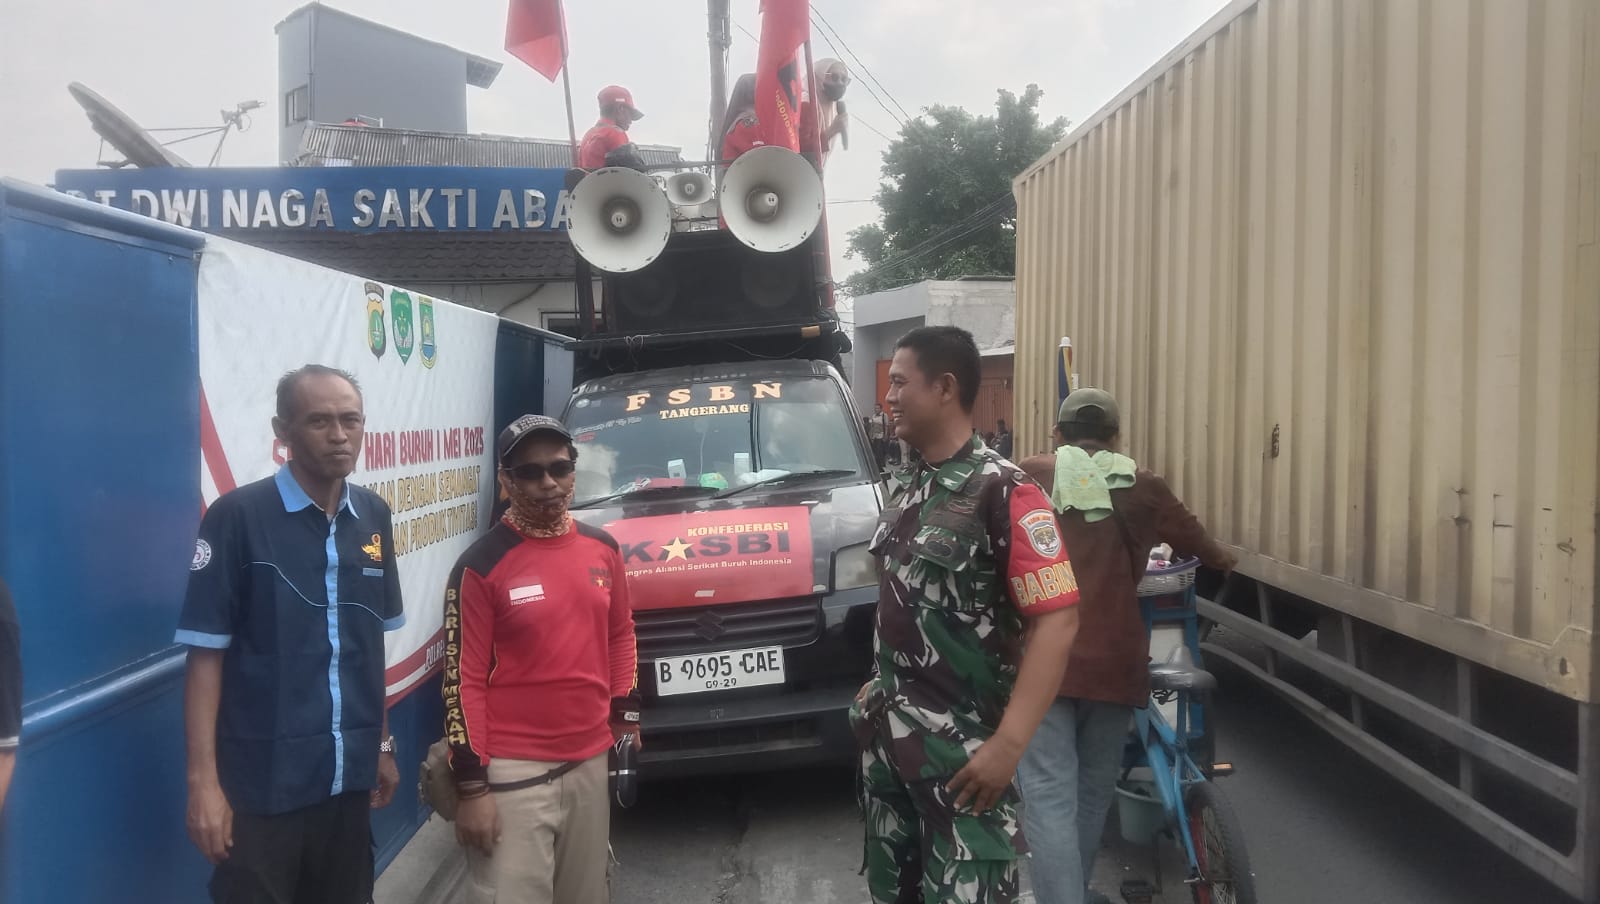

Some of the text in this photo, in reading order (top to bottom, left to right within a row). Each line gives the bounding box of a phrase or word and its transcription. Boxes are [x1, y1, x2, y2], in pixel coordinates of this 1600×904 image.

[131, 189, 208, 228] DWI
[223, 188, 335, 228] NAGA
[353, 188, 477, 228] SAKTI
[492, 189, 569, 229] ABA
[660, 404, 749, 420] TANGERANG
[364, 431, 396, 472] HARI
[399, 429, 434, 466] BURUH
[443, 427, 462, 460] MEI
[464, 426, 484, 458] 2025
[397, 472, 438, 514] DENGAN
[438, 465, 481, 503] SEMANGAT
[393, 520, 409, 558] AN
[687, 522, 789, 537] KONFEDERASI
[621, 532, 791, 564] KASBI
[625, 557, 792, 578] ngres Aliansi Serikat Buruh Indonesia
[1010, 560, 1079, 608] BABIN
[443, 588, 466, 745] BARISAN MERAH
[660, 650, 780, 683] B 9695 CAE
[705, 677, 737, 689] 09-29
